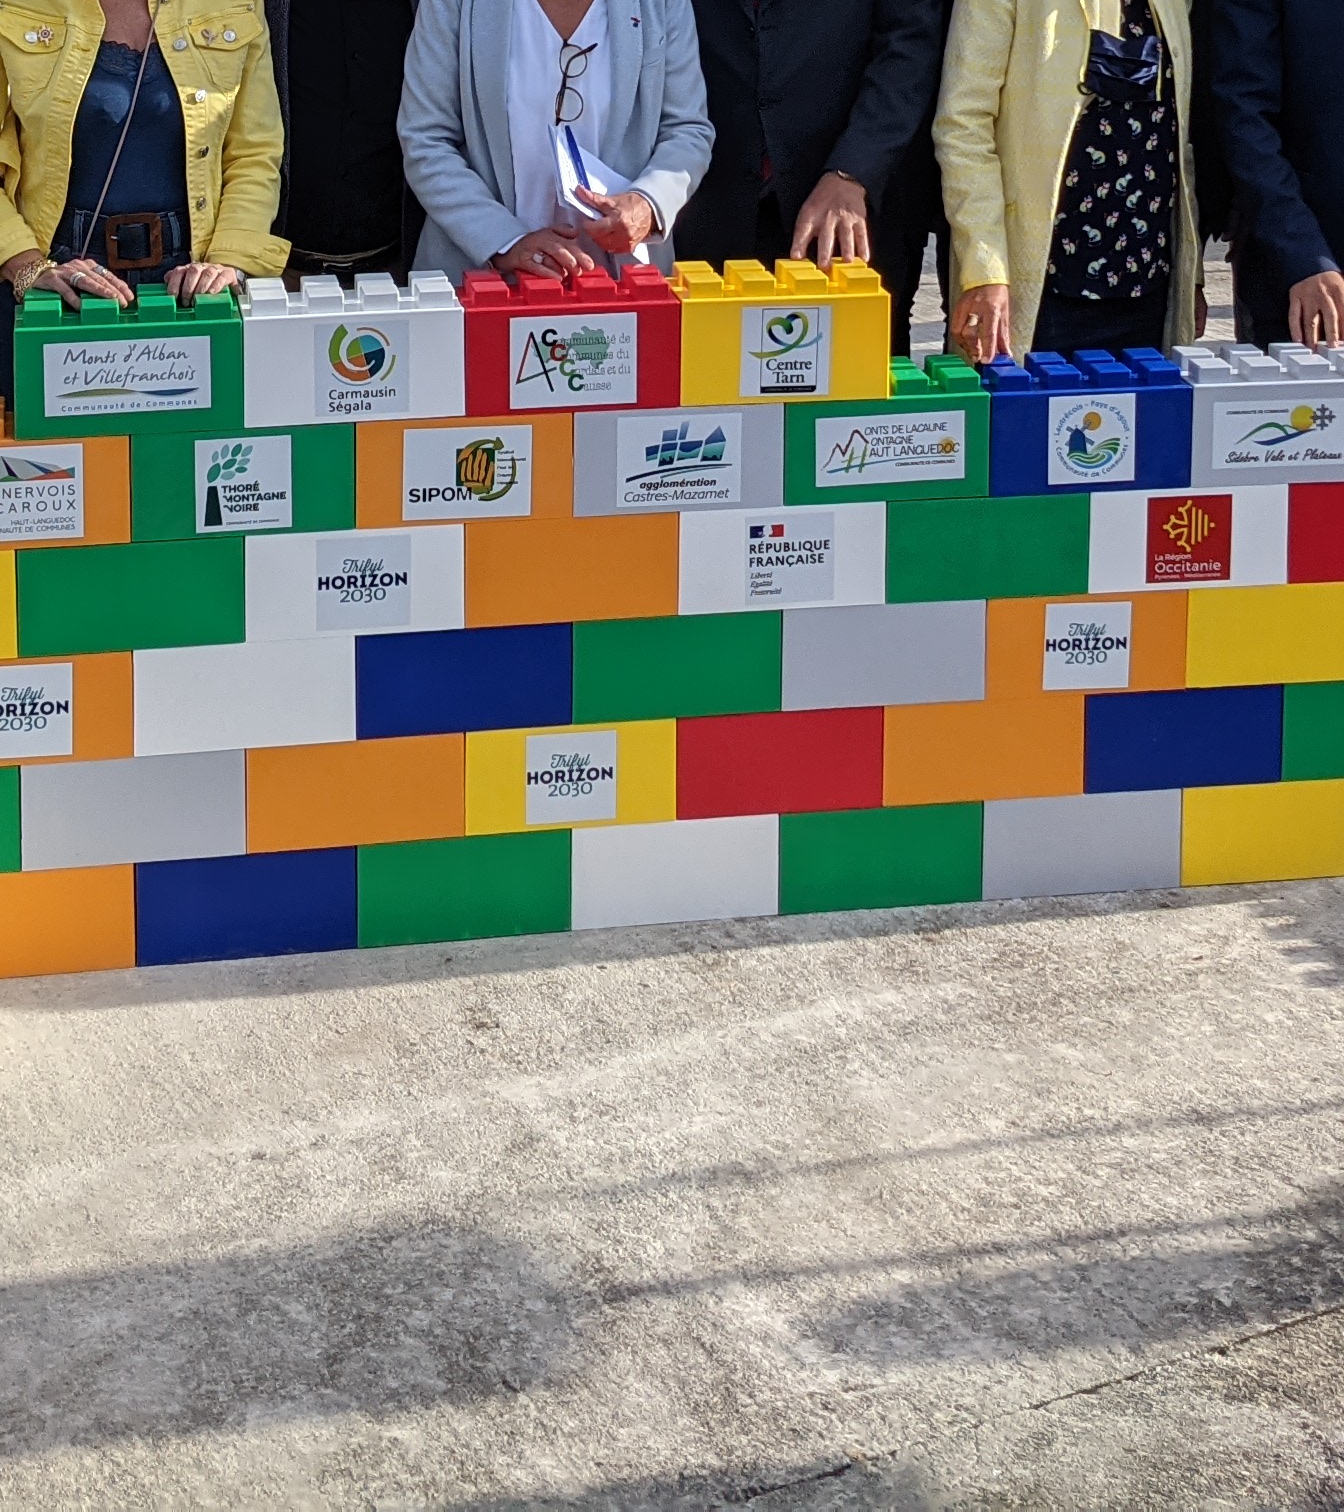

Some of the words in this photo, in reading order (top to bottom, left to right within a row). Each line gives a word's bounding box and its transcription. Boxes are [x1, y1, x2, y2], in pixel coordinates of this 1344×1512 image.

[63, 348, 118, 365] Monts
[123, 343, 190, 364] d'Alban
[765, 358, 813, 371] Centre
[63, 371, 80, 386] et
[83, 362, 197, 388] Villefranchois
[772, 371, 806, 384] Tarn
[328, 385, 397, 401] Carmausin
[61, 402, 126, 413] Communauté
[130, 401, 142, 409] de
[145, 399, 198, 408] Communes
[328, 399, 372, 415] Ségala
[891, 424, 905, 435] DE
[906, 421, 948, 434] LACAUNE
[893, 442, 961, 457] LANGUEDOC
[221, 480, 260, 495] THORÉ
[639, 477, 717, 492] agglomération
[222, 491, 287, 504] MONTAGNE
[408, 486, 473, 503] SIPOM
[623, 488, 730, 504] Castres-Mazamet
[222, 503, 260, 514] NOIRE
[748, 538, 831, 555] RÉPUBLIQUE
[748, 553, 825, 568] FRANÇAISE
[1154, 554, 1164, 562] La
[1154, 559, 1222, 573] Occitanie
[342, 558, 385, 576] Trifyl
[317, 571, 408, 591] HORIZON
[339, 587, 387, 604] 2030
[1067, 623, 1107, 638] Trifyl
[1045, 636, 1128, 653] HORIZON
[1064, 650, 1108, 666] 2030
[0, 686, 45, 703] Trifyl
[550, 753, 591, 770] Trifyl
[526, 766, 614, 786] HORIZON
[547, 781, 593, 798] 2030
